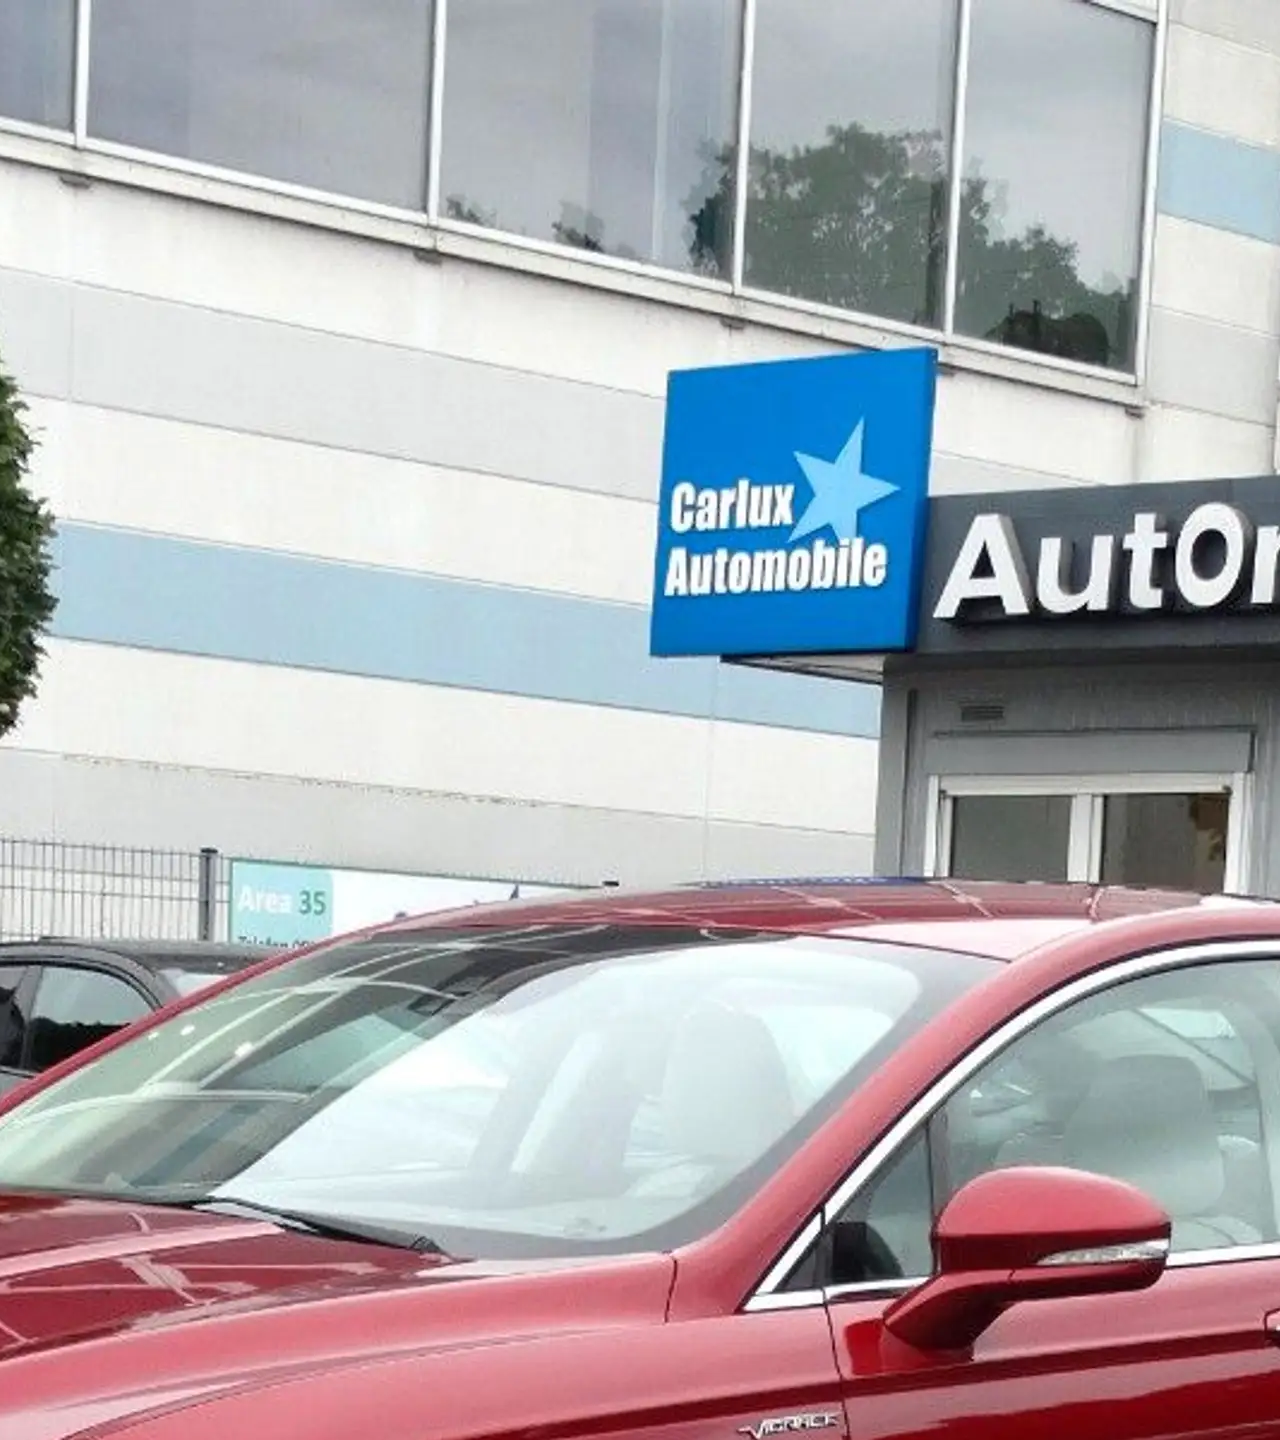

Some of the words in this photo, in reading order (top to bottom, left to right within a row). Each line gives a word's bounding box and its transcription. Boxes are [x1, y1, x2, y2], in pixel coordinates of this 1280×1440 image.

[671, 479, 795, 533] Carlux
[664, 536, 888, 597] Automobile
[238, 884, 292, 914] Area
[298, 889, 326, 915] 35
